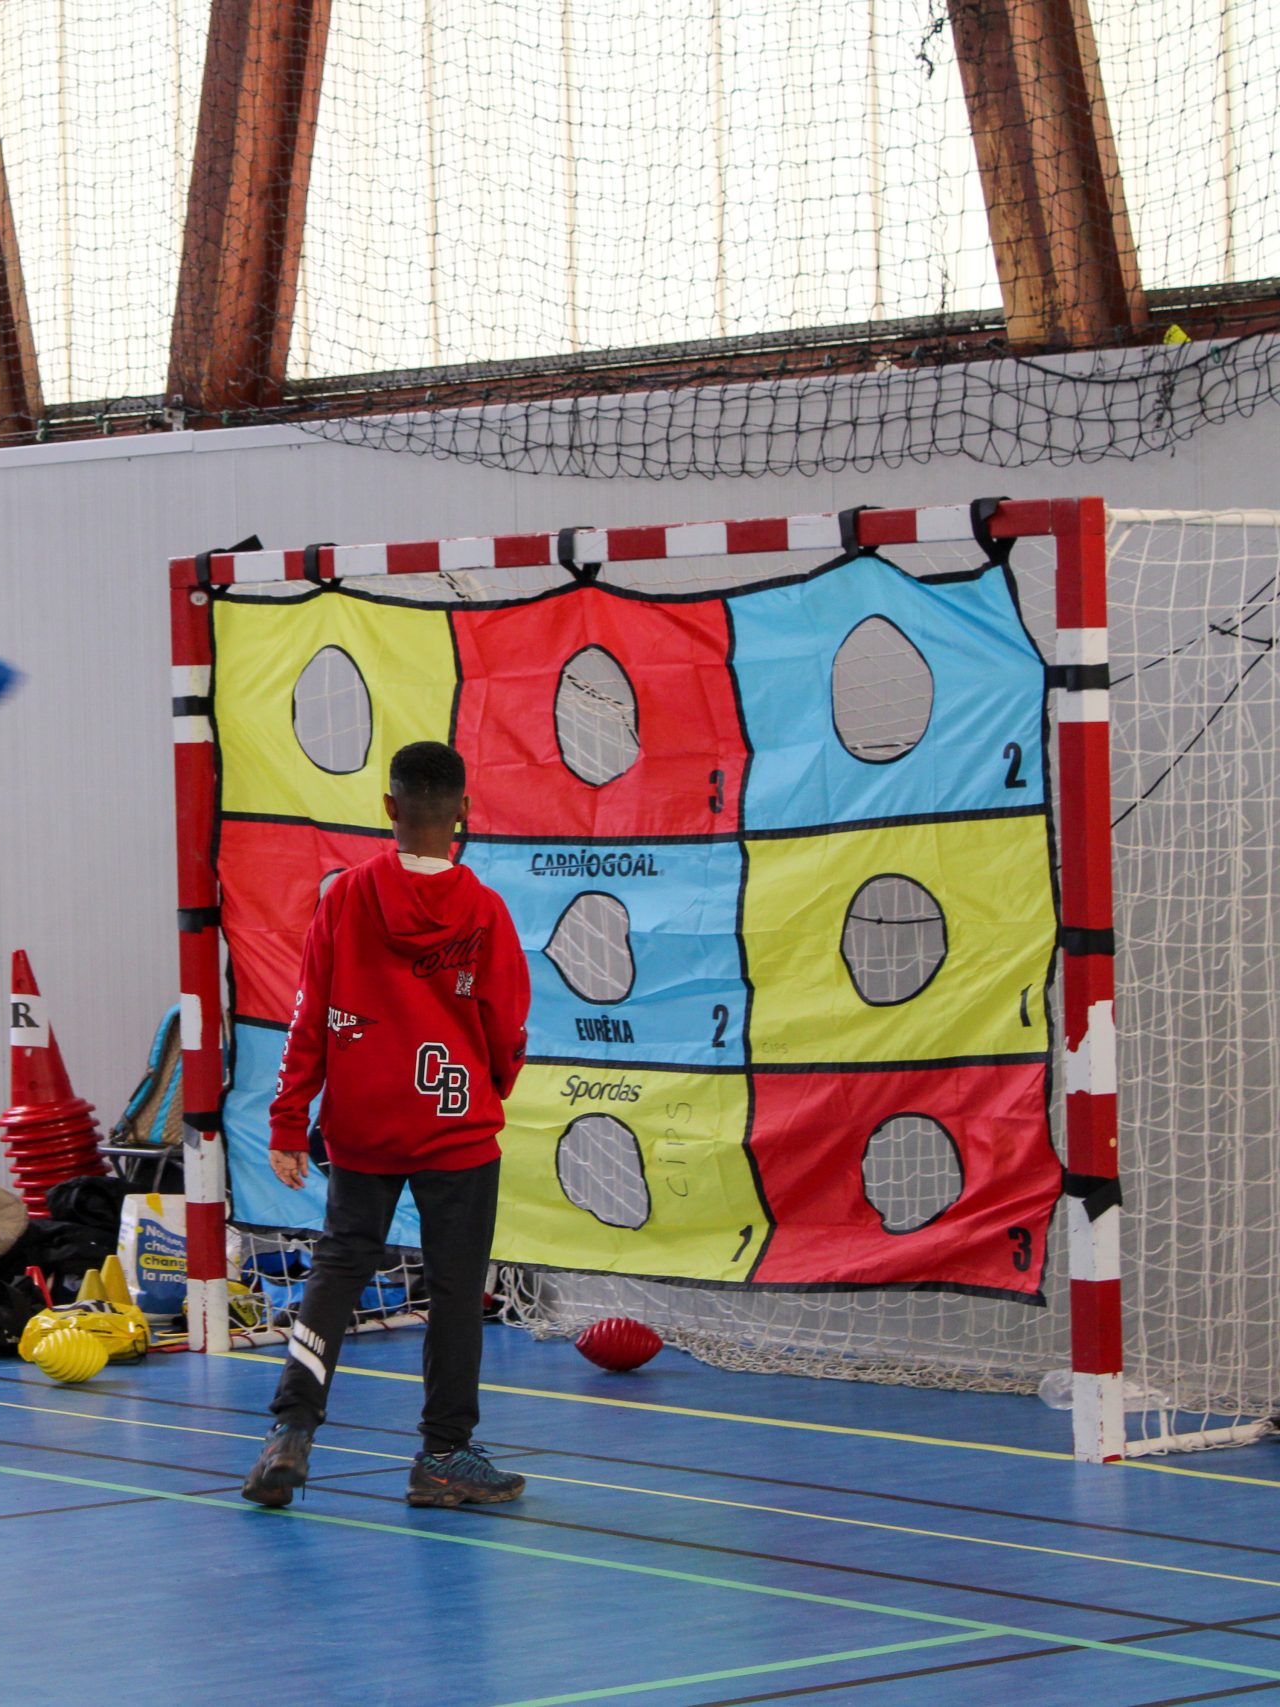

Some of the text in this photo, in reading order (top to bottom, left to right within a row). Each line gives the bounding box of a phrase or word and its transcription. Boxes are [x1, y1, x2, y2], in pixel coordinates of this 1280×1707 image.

[1003, 741, 1027, 789] 2
[708, 769, 724, 814] 3
[11, 1002, 40, 1028] R
[575, 1014, 635, 1044] EURÊKA
[711, 1003, 729, 1048] 2
[414, 1042, 470, 1117] CB
[560, 1074, 642, 1106] Spordas
[731, 1225, 753, 1263] 1
[1008, 1226, 1033, 1272] 3
